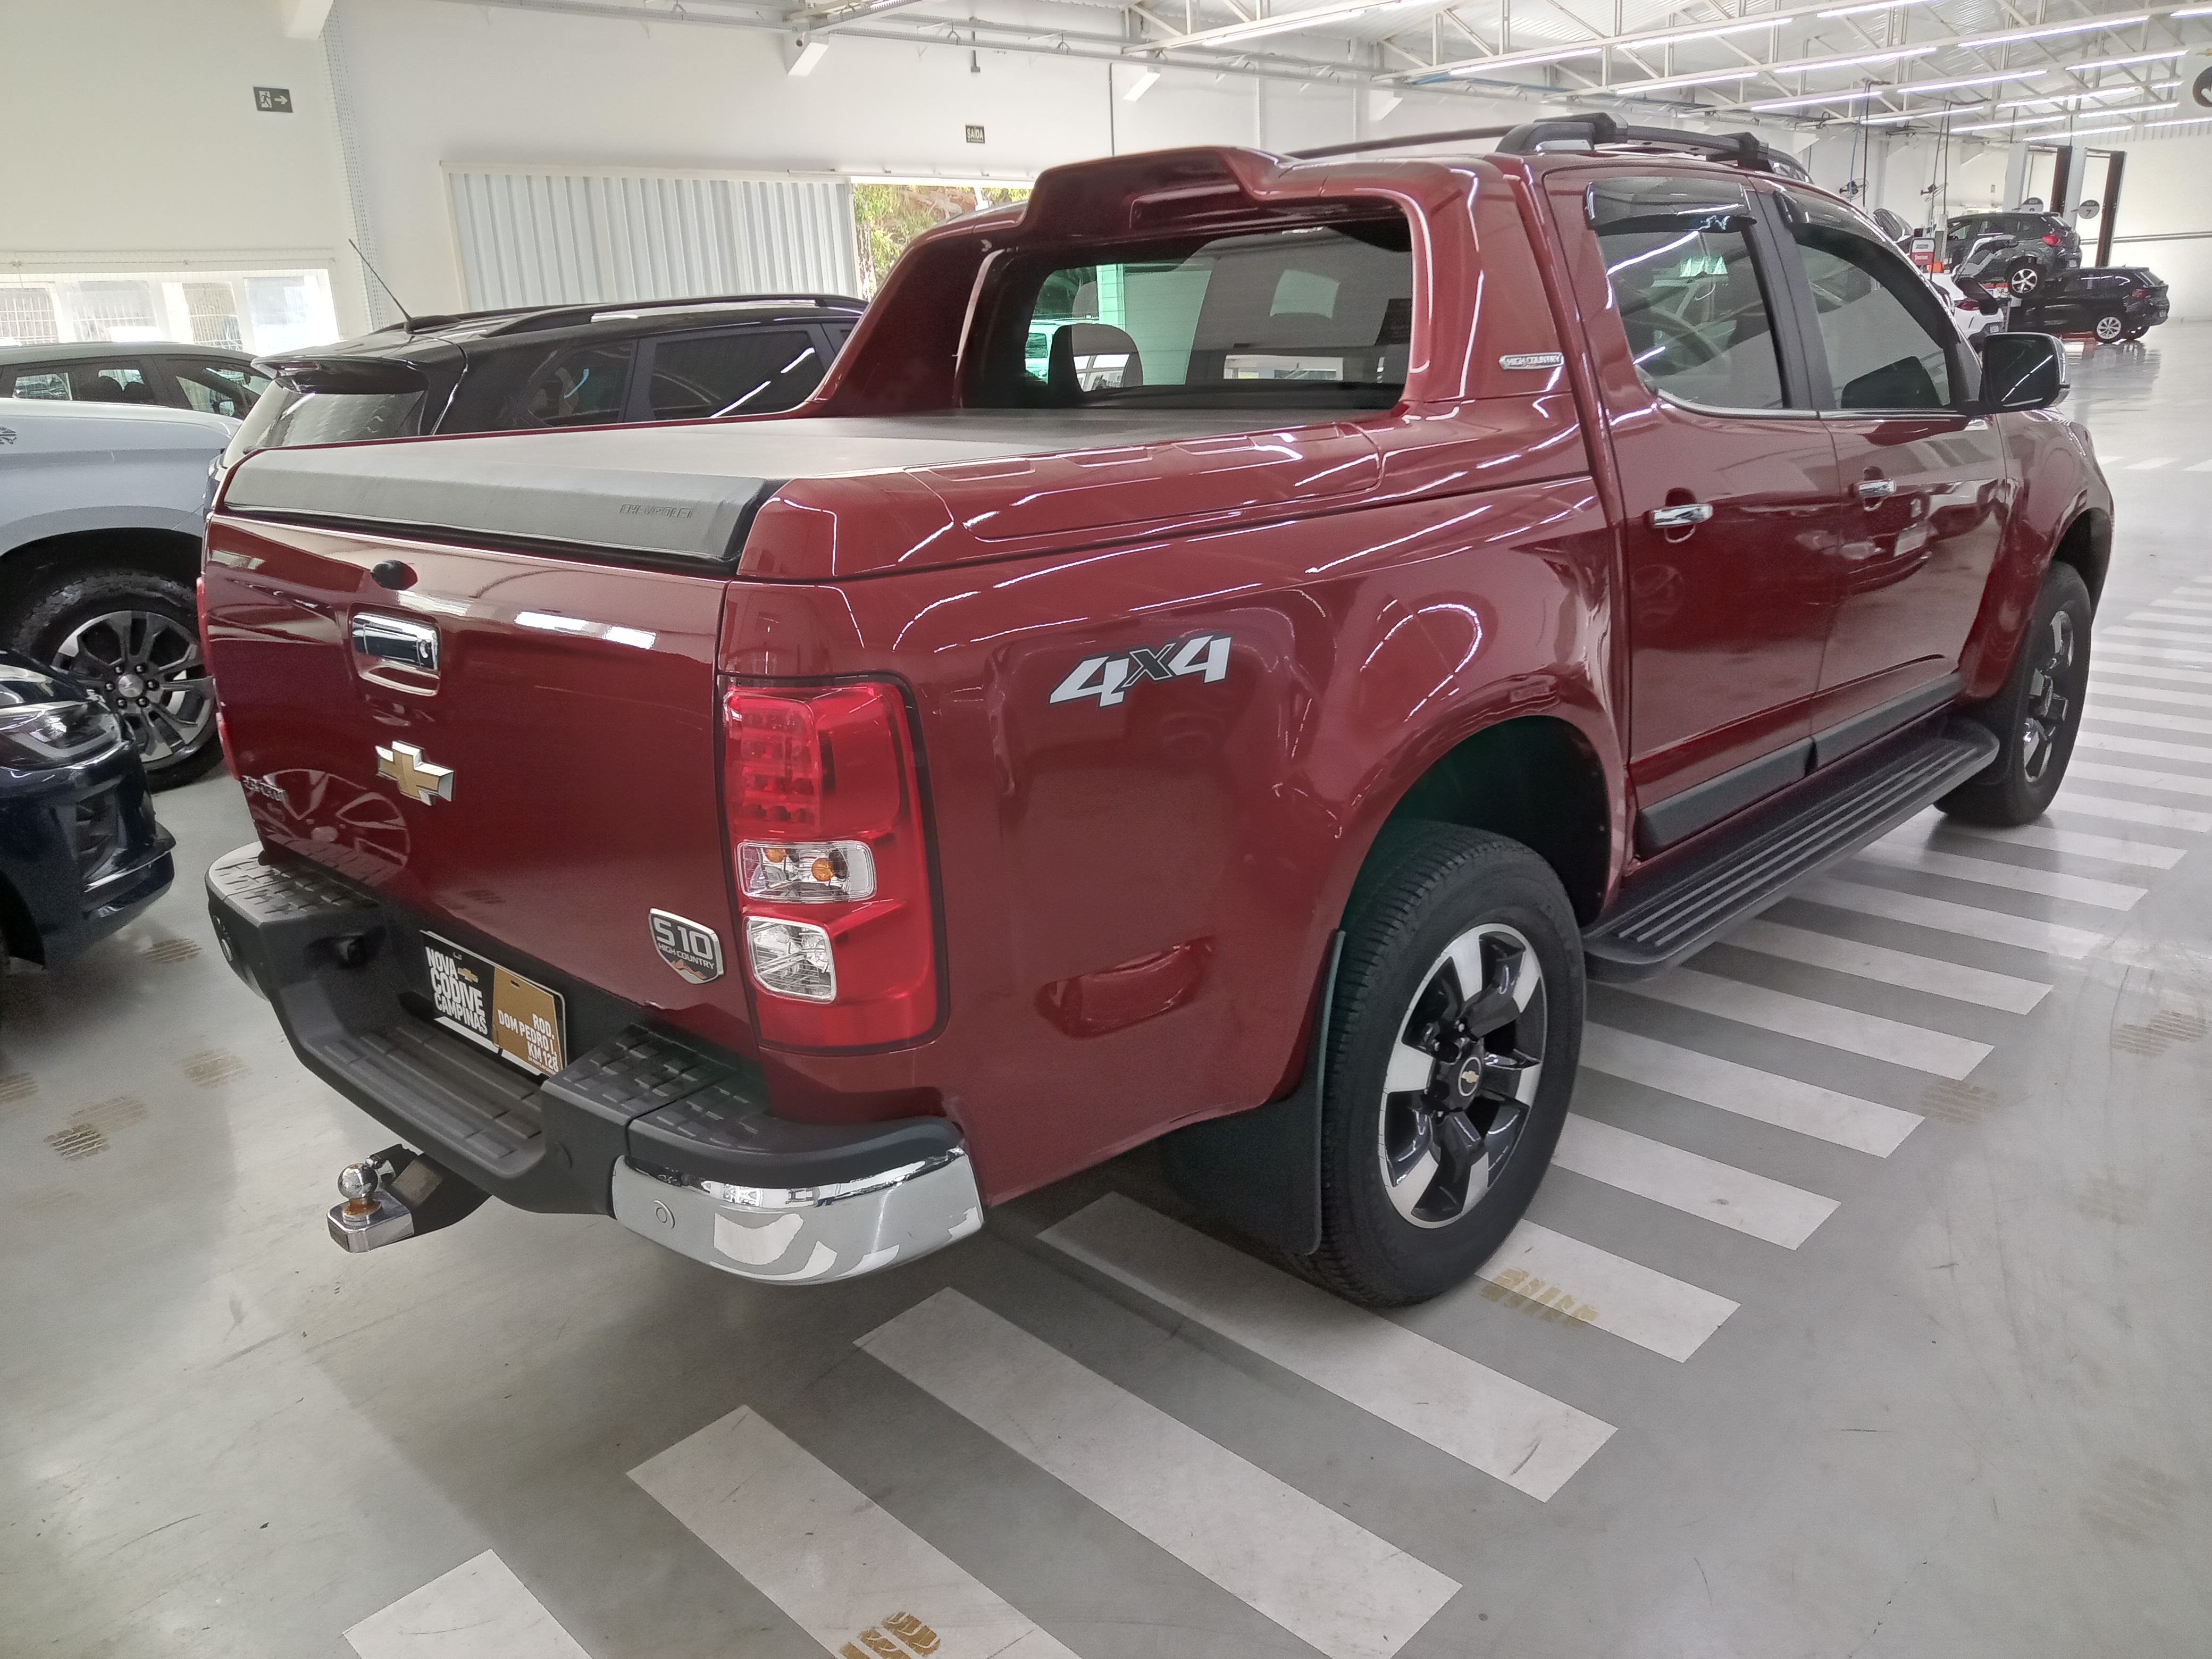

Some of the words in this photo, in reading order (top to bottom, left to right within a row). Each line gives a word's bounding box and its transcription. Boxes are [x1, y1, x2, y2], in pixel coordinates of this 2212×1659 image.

[967, 126, 984, 140] SAÍDA
[619, 504, 695, 518] CHEVROLET
[653, 917, 713, 960] S10
[425, 946, 458, 980] NOVA
[658, 942, 676, 956] HIGH
[676, 950, 715, 969] COUNTRY
[430, 967, 485, 1018] CODIVE
[434, 992, 488, 1035] CAMPINAS
[532, 1013, 555, 1040] ROD.
[497, 1009, 518, 1034] DOM
[518, 1020, 549, 1052] PEDRO
[527, 1041, 542, 1063] KM
[542, 1051, 559, 1073] 128
